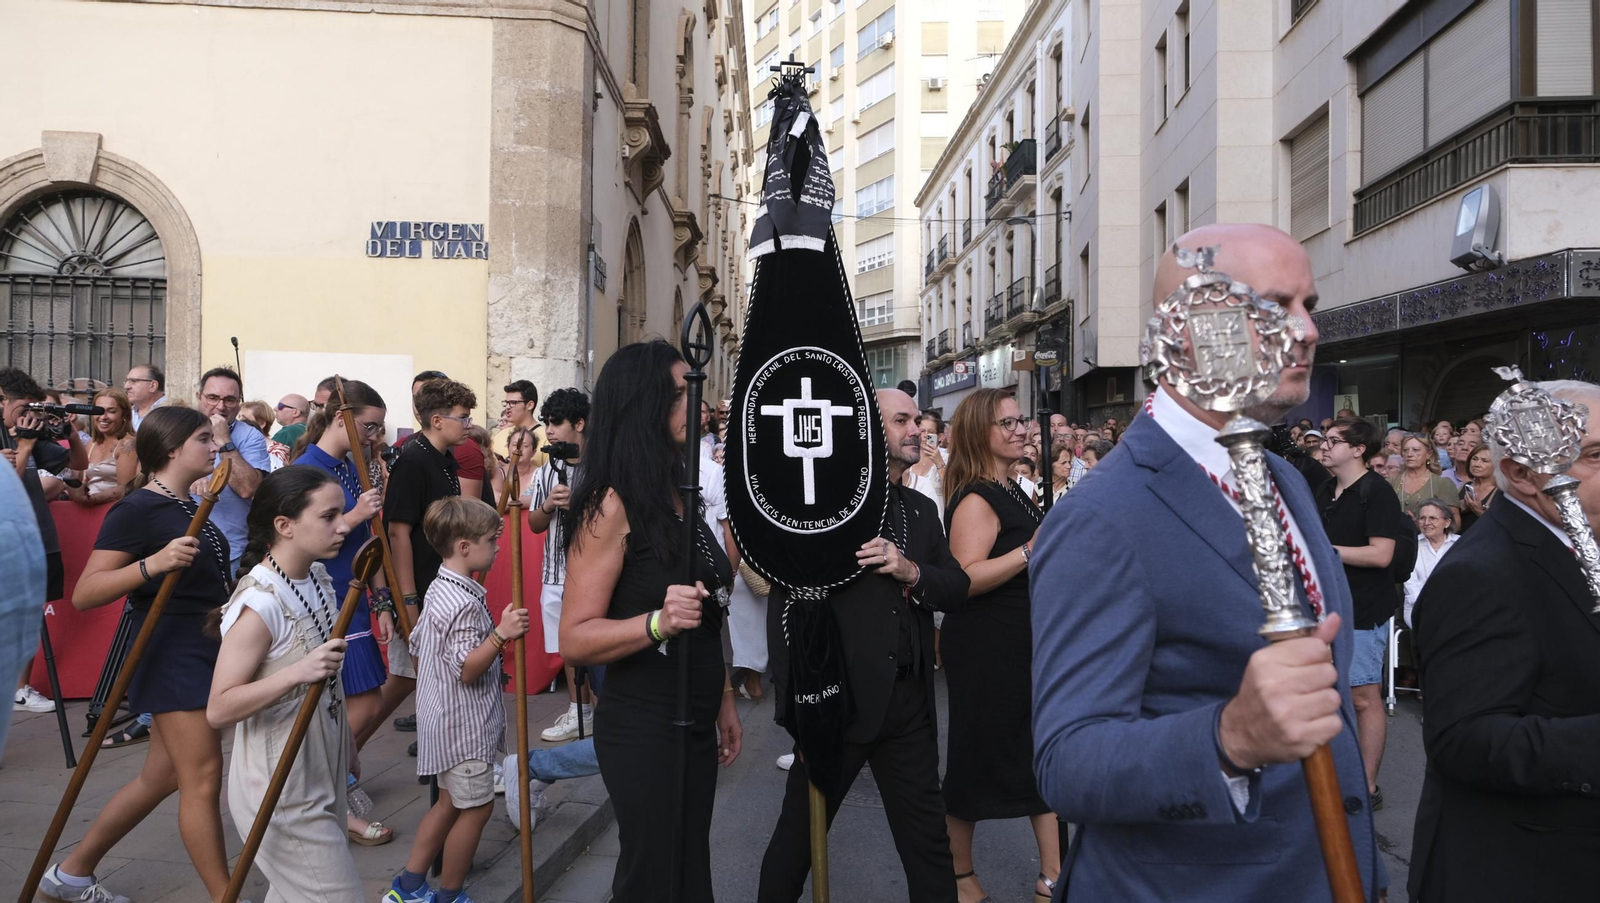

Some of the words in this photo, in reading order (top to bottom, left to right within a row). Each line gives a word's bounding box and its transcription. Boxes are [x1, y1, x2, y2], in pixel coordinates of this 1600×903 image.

[371, 221, 484, 240] VIRGEN
[366, 239, 420, 258] DEL
[432, 240, 488, 259] MAR
[783, 353, 801, 364] DEL
[805, 351, 832, 364] SANTO
[756, 361, 782, 390] JUVENIL
[832, 360, 856, 385] CRISTO
[853, 386, 864, 403] DEL
[748, 390, 759, 444] HERMANDAD
[857, 405, 867, 440] PERDON
[750, 474, 779, 519] VIA-CRUCIS
[780, 515, 840, 529] PENITENCIAL
[839, 507, 852, 519] DE
[850, 467, 869, 508] SILENCIO
